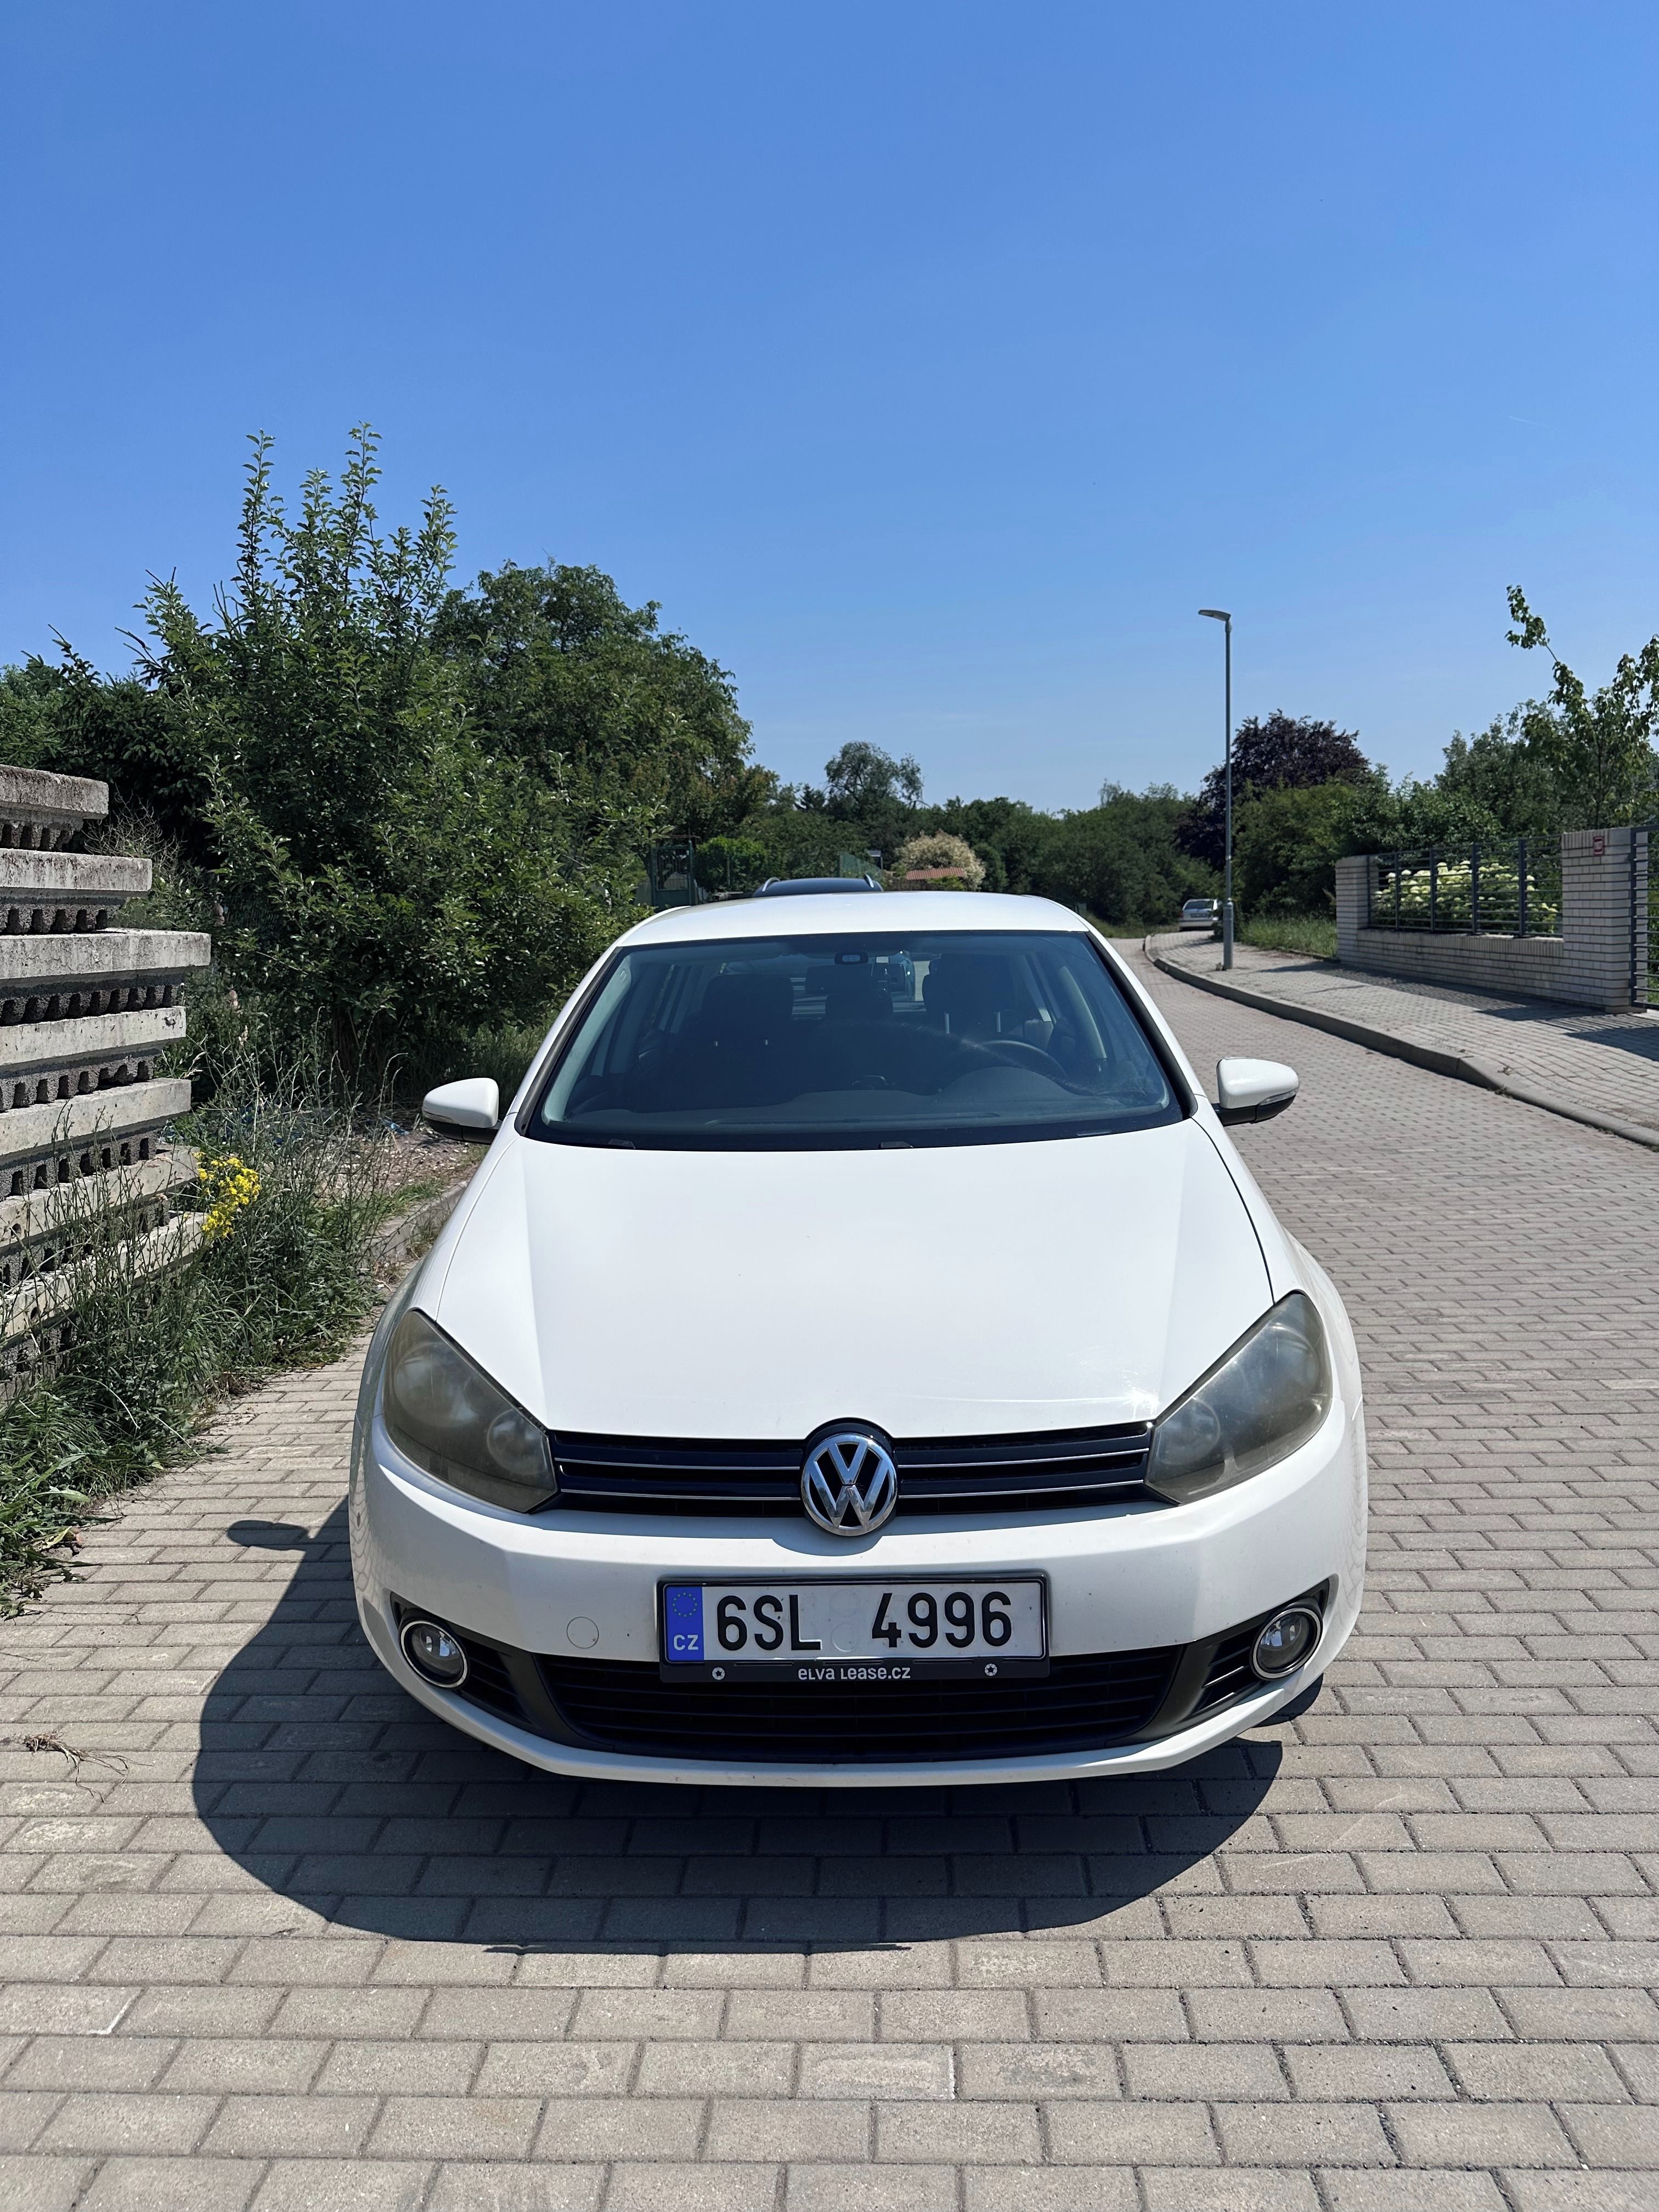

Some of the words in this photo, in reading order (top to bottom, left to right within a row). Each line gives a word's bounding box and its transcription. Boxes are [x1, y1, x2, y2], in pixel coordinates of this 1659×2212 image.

[716, 1594, 821, 1651] 6SL
[871, 1591, 1012, 1648] 4996
[673, 1634, 699, 1650] CZ
